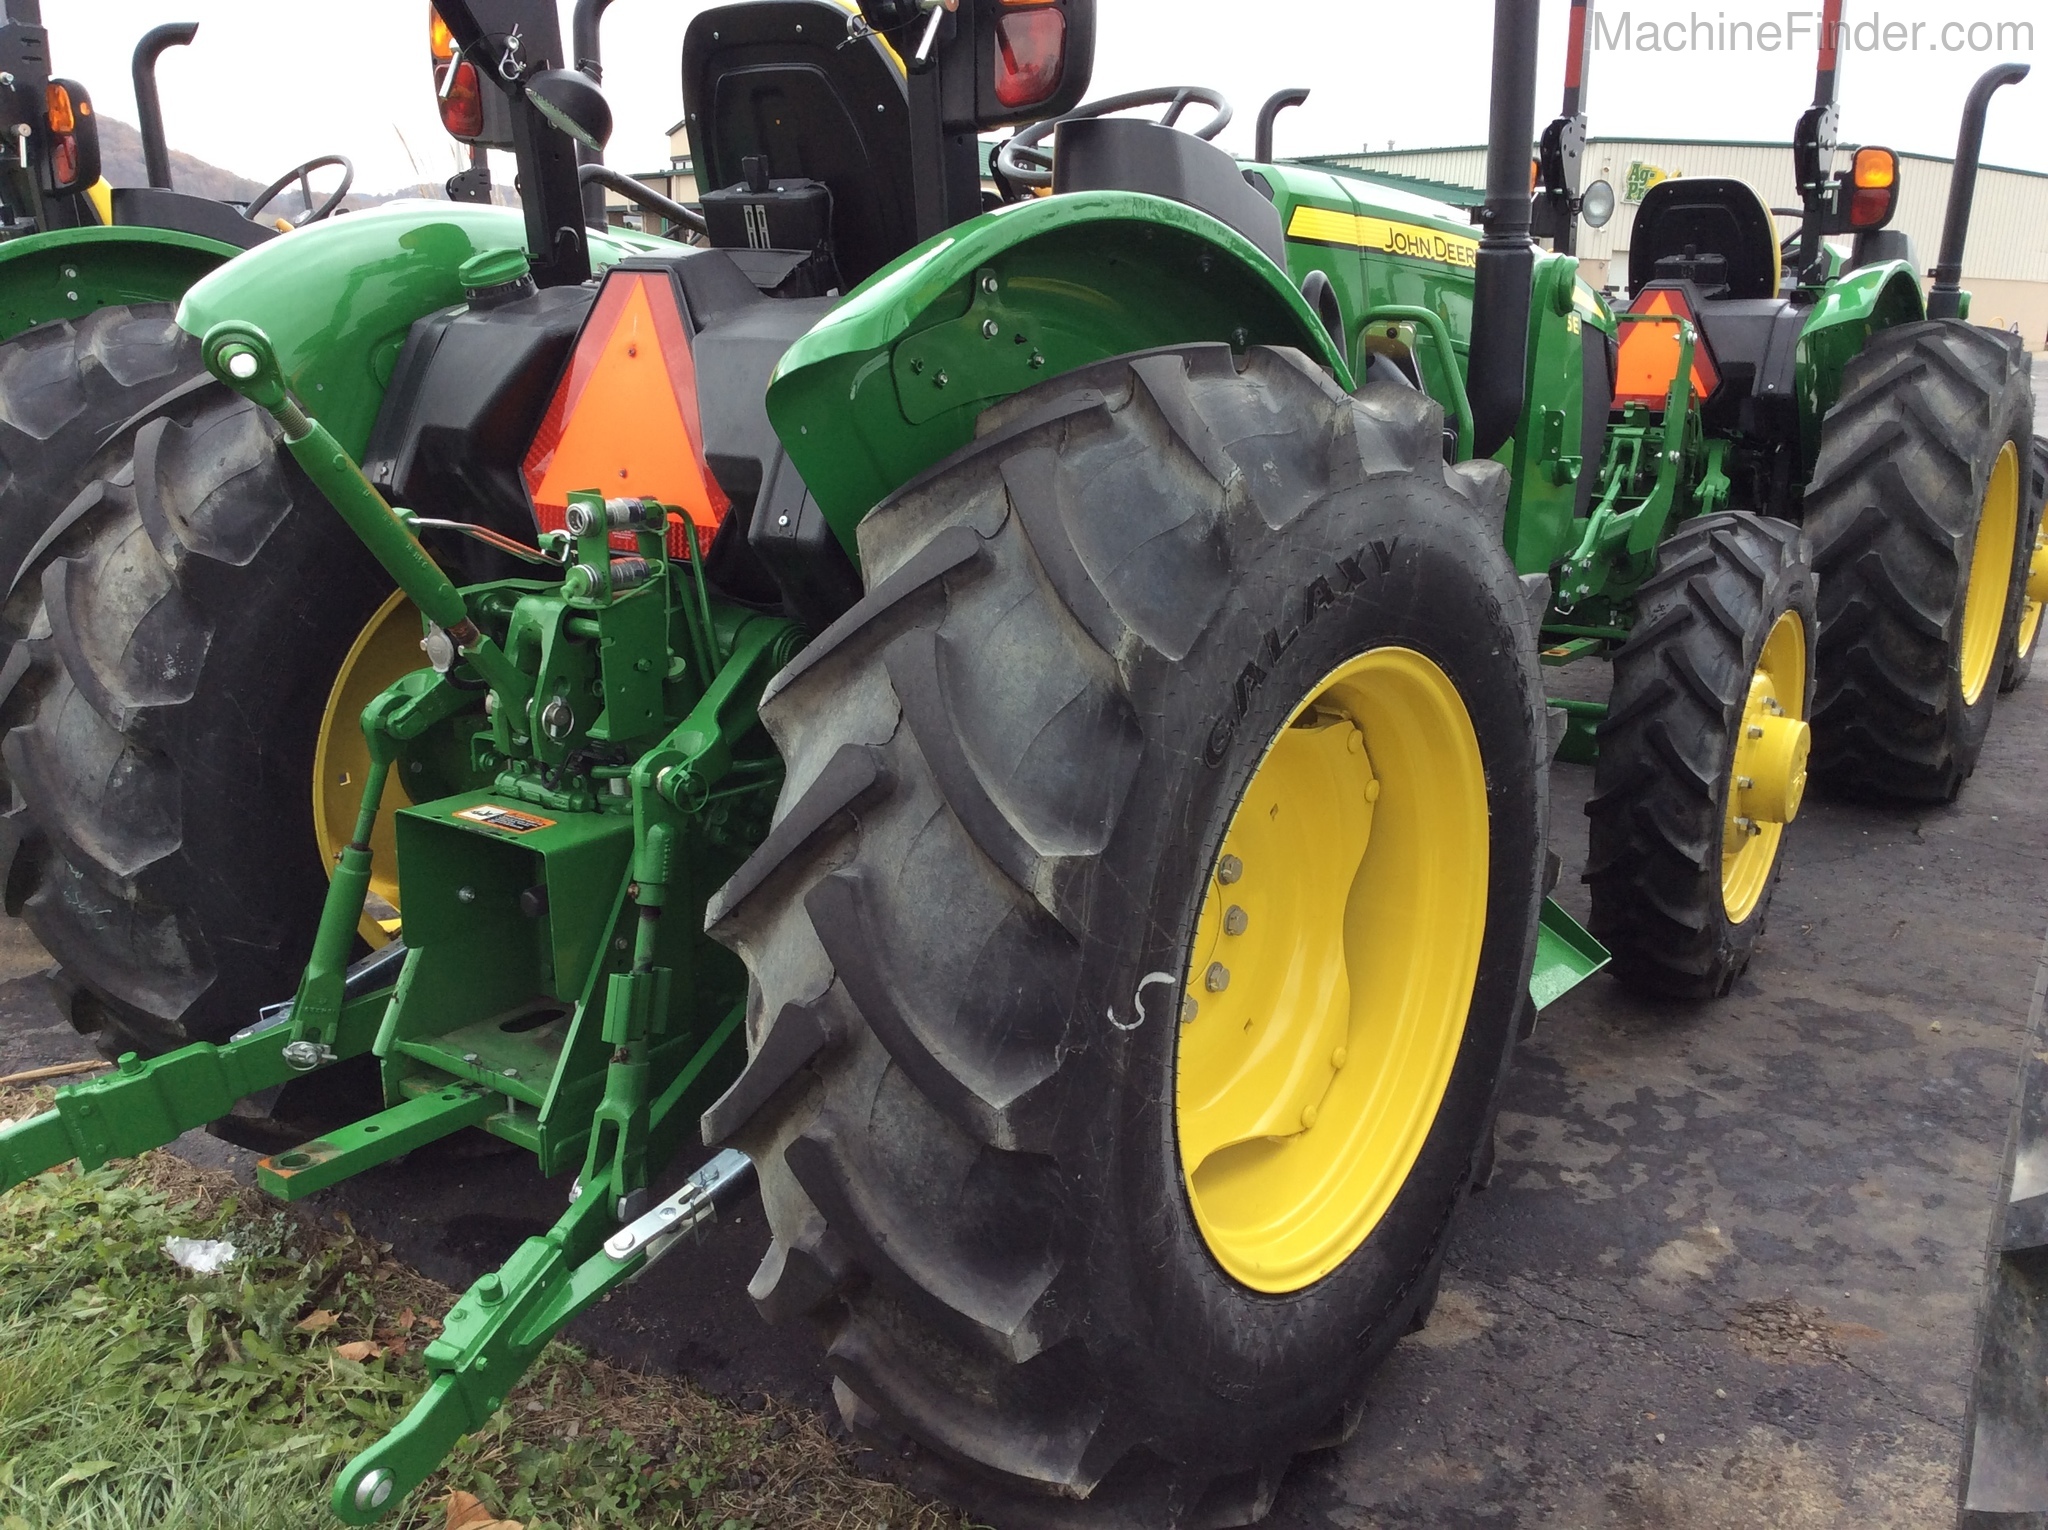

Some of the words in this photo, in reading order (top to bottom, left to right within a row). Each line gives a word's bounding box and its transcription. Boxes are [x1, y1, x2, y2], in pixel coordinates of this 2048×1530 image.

[1625, 182, 1648, 201] Pr
[1384, 227, 1431, 256] JOHN
[1433, 235, 1478, 265] DEER
[1204, 536, 1399, 769] GALAXY
